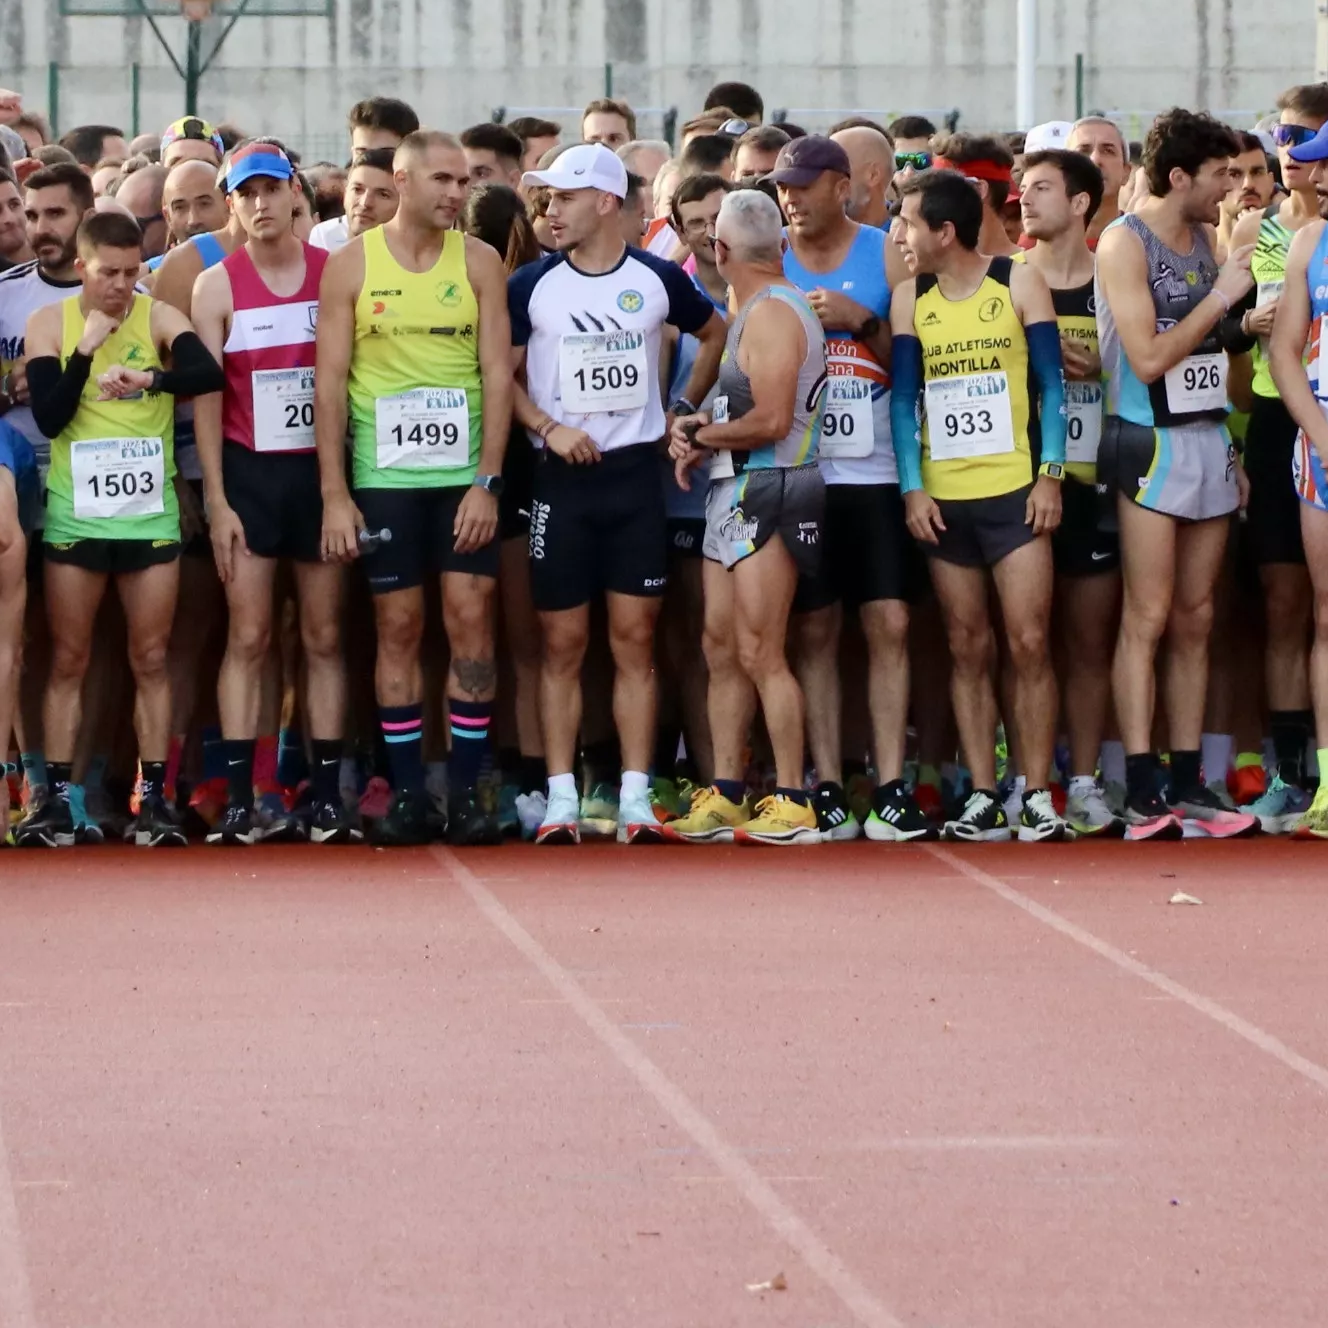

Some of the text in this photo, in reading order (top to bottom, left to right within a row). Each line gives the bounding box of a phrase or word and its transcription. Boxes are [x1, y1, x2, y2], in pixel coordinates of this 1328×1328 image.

[945, 337, 1011, 354] ATLETISMO
[574, 364, 638, 391] 1509
[929, 356, 1001, 377] MONTILLA
[1184, 365, 1220, 391] 926
[391, 423, 458, 446] 1499
[822, 413, 854, 436] 90
[944, 410, 993, 437] 933
[88, 471, 154, 497] 1503
